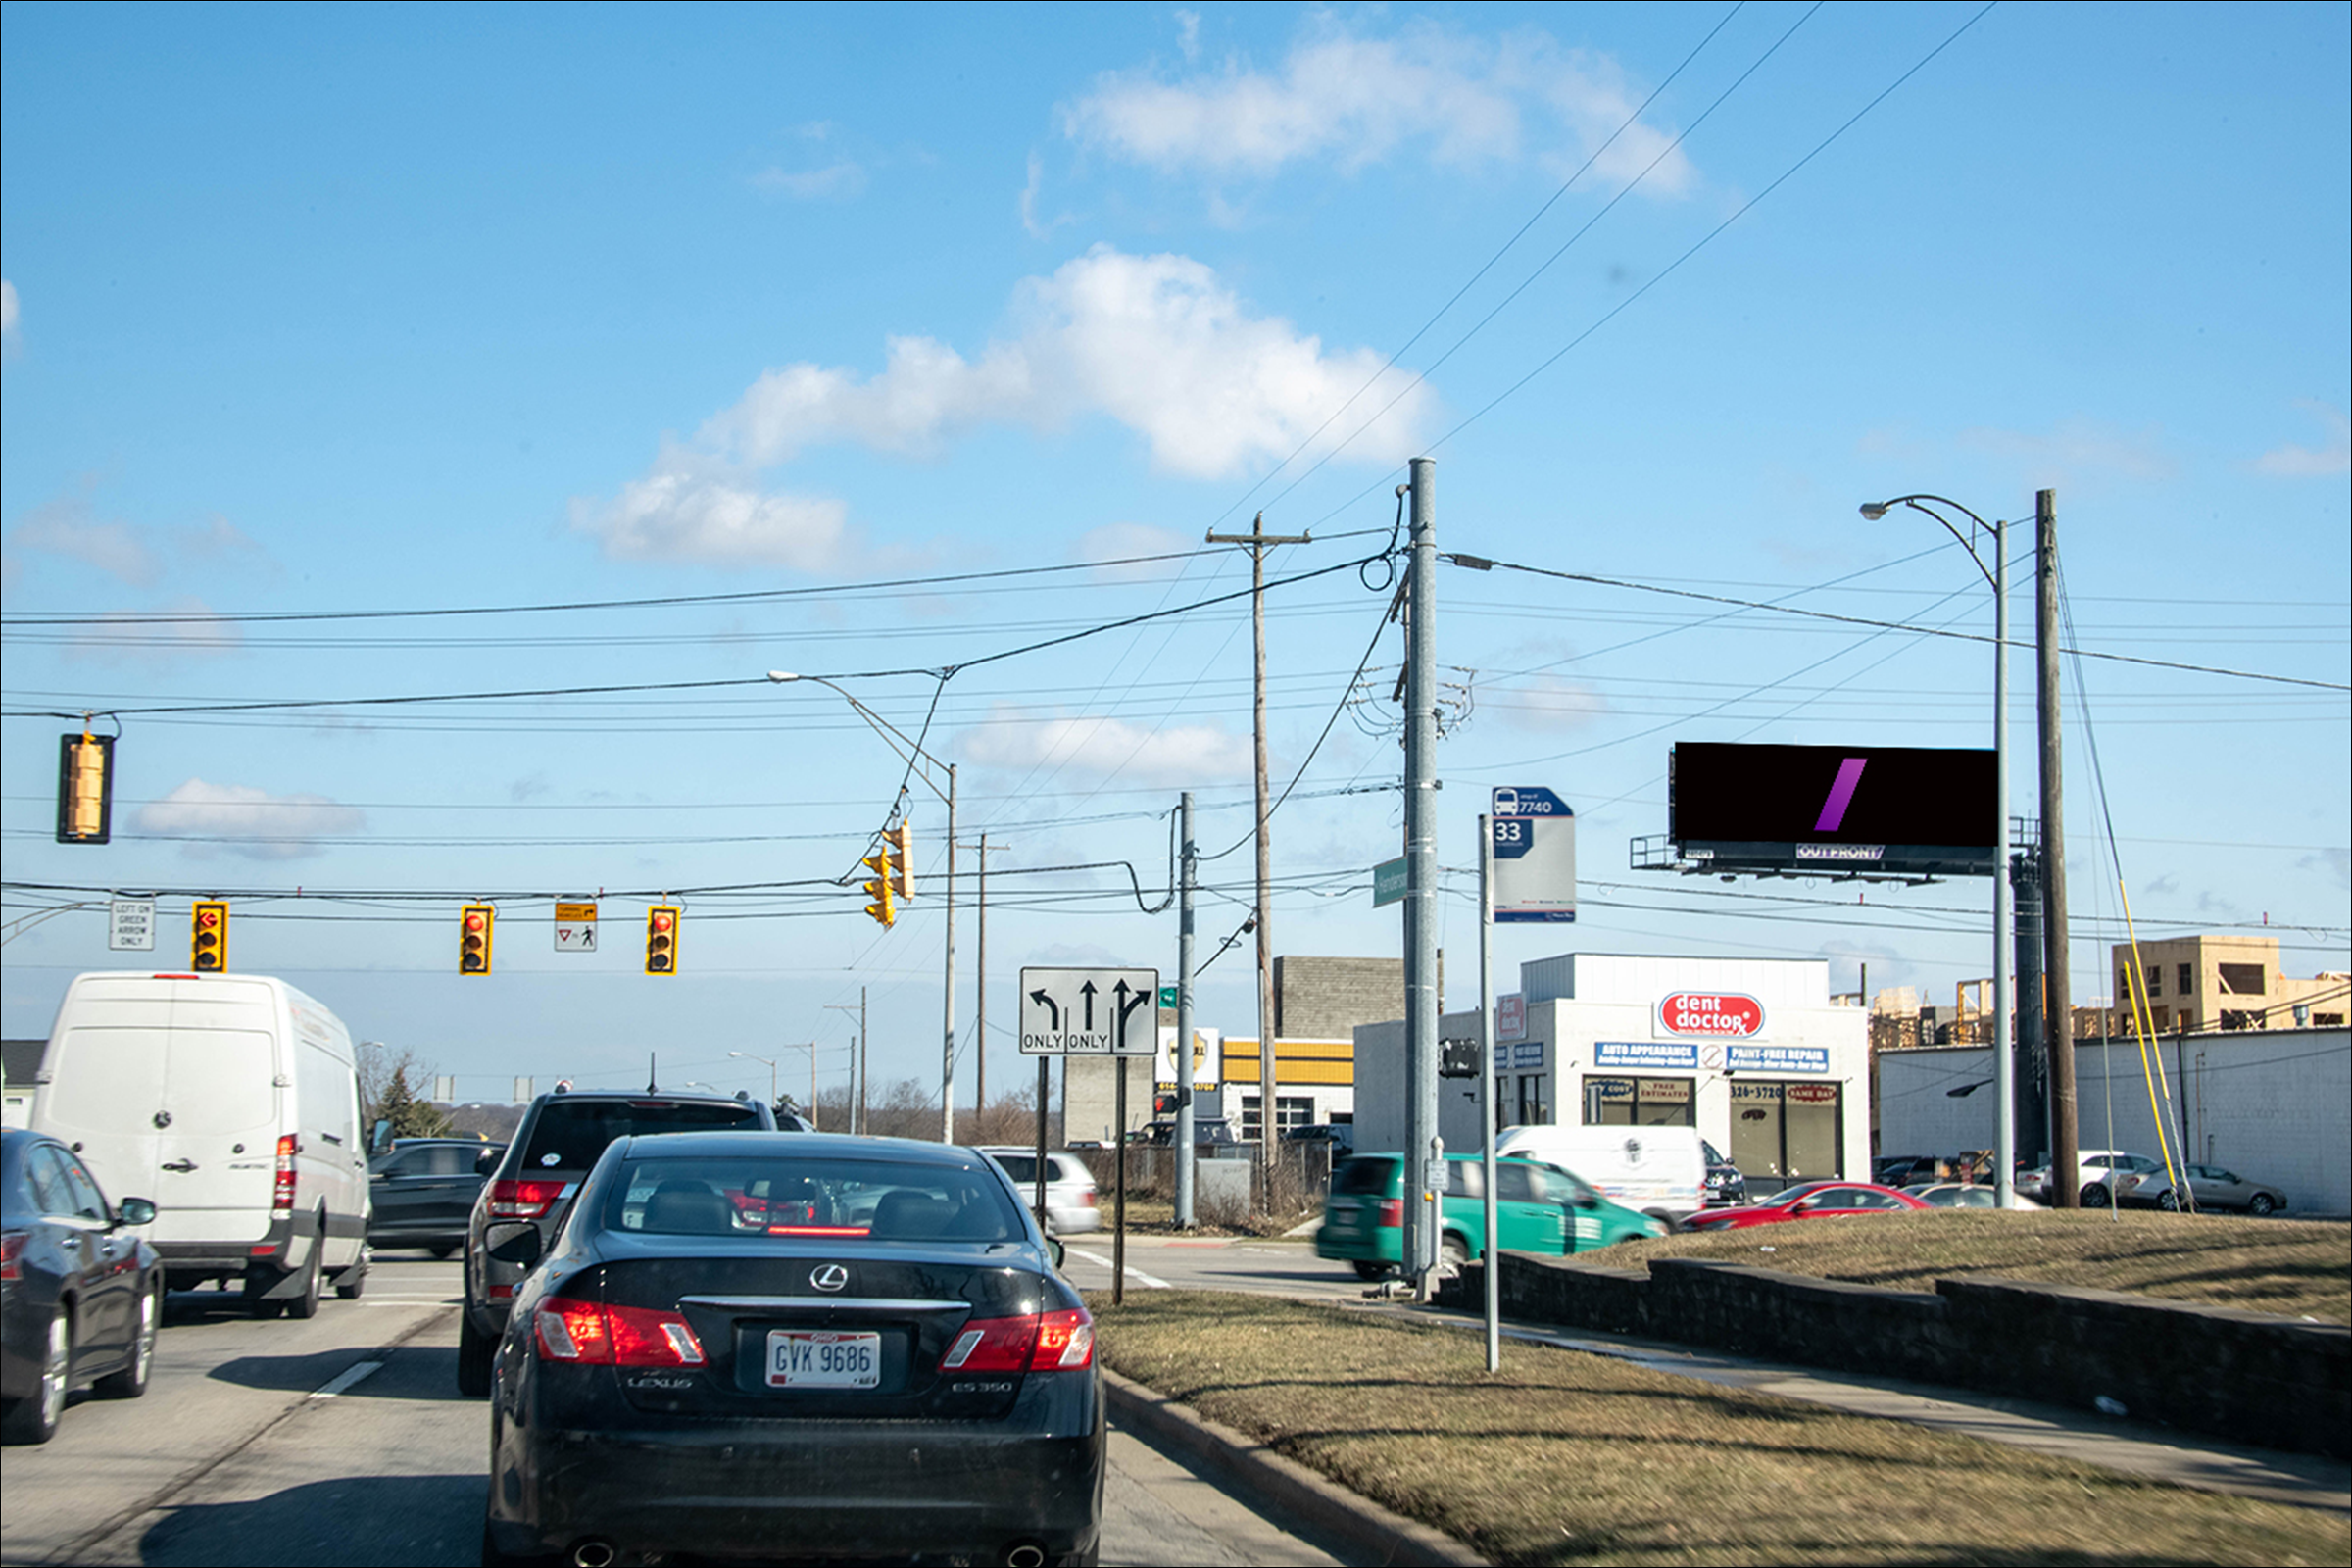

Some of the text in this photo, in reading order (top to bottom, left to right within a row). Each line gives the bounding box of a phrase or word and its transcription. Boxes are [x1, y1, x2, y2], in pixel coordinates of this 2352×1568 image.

[1519, 801, 1553, 813] 7740
[1495, 822, 1522, 842] 33
[116, 905, 150, 913] LEFT ON
[119, 915, 146, 924] GREEN
[120, 937, 143, 946] ONLY
[1676, 994, 1721, 1011] dent
[1023, 1034, 1063, 1048] ONLY
[1068, 1034, 1108, 1048] ONLY
[1602, 1044, 1692, 1057] AUTO APPEARANCE
[1731, 1048, 1824, 1061] PAINT-FREE REPAIR
[775, 1344, 871, 1372] GVK 9686
[628, 1378, 693, 1389] LEXUS
[952, 1381, 1013, 1393] ES 350
